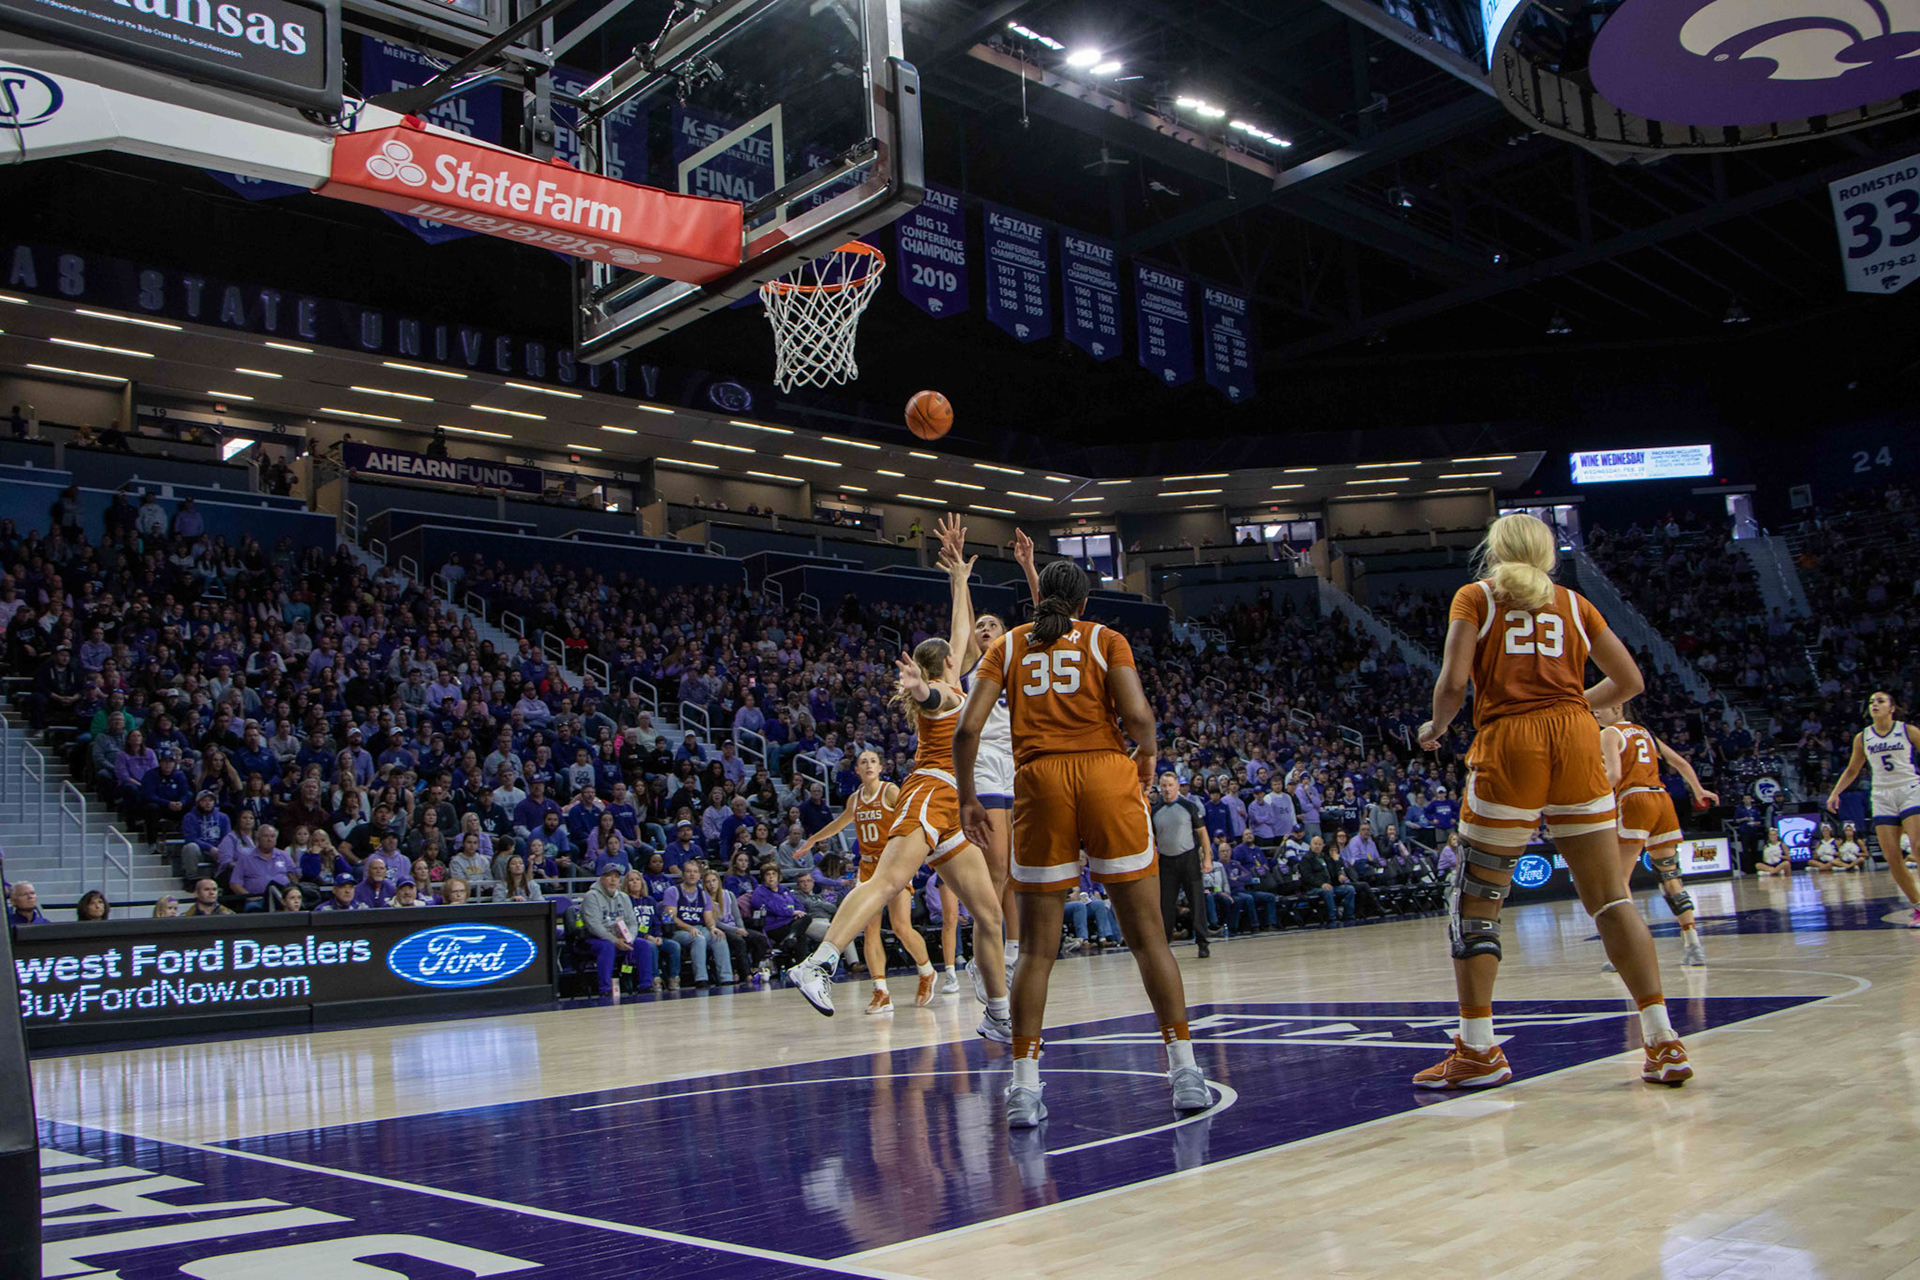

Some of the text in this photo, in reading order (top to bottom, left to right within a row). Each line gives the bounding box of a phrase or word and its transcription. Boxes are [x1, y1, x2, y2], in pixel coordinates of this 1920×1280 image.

[112, 0, 307, 55] ansas
[383, 45, 416, 62] MEN'S
[696, 166, 760, 201] FINAL
[1840, 166, 1918, 201] ROMSTAD
[915, 214, 949, 235] BIG 12
[990, 211, 1043, 240] K-STATE
[1844, 188, 1920, 260] 33
[902, 225, 965, 252] CONFERENCE
[996, 240, 1040, 259] CONFERENCE
[1065, 236, 1114, 262] K-STATE
[902, 236, 966, 266] CHAMPIONS
[990, 246, 1046, 269] CHAMPIONSHIPS
[997, 264, 1040, 283] 1917 1951
[1072, 262, 1111, 280] CONFERENCE
[1863, 254, 1917, 276] 1979-82
[911, 263, 958, 293] 2019
[998, 275, 1042, 295] 1919 1956
[1067, 268, 1118, 291] CHAMPIONSHIPS
[1139, 267, 1185, 292] K-STATE
[999, 287, 1043, 306] 1948 1958
[999, 298, 1044, 317] 1950 1959
[1145, 292, 1183, 310] CONFERENCE
[1204, 288, 1246, 311] K-STATE
[1140, 299, 1189, 319] CHAMPIONSHIPS
[139, 269, 318, 338] STATE
[360, 311, 661, 398] UNIVERSITY
[152, 407, 167, 418] 19
[272, 422, 286, 434] 20
[1580, 451, 1645, 467] WINE WEDNESDAY
[1851, 445, 1893, 473] 24
[1505, 610, 1564, 658] 23
[1022, 649, 1081, 697] 35
[1635, 738, 1650, 763] 2
[1867, 742, 1905, 755] Wildcats
[1881, 754, 1895, 772] 5
[856, 810, 882, 821] TEXAS
[860, 822, 879, 843] 10
[131, 940, 225, 977] Ford
[233, 935, 372, 970] Dealers
[418, 934, 508, 976] Ford
[20, 975, 311, 1021] BuyFordNow.com
